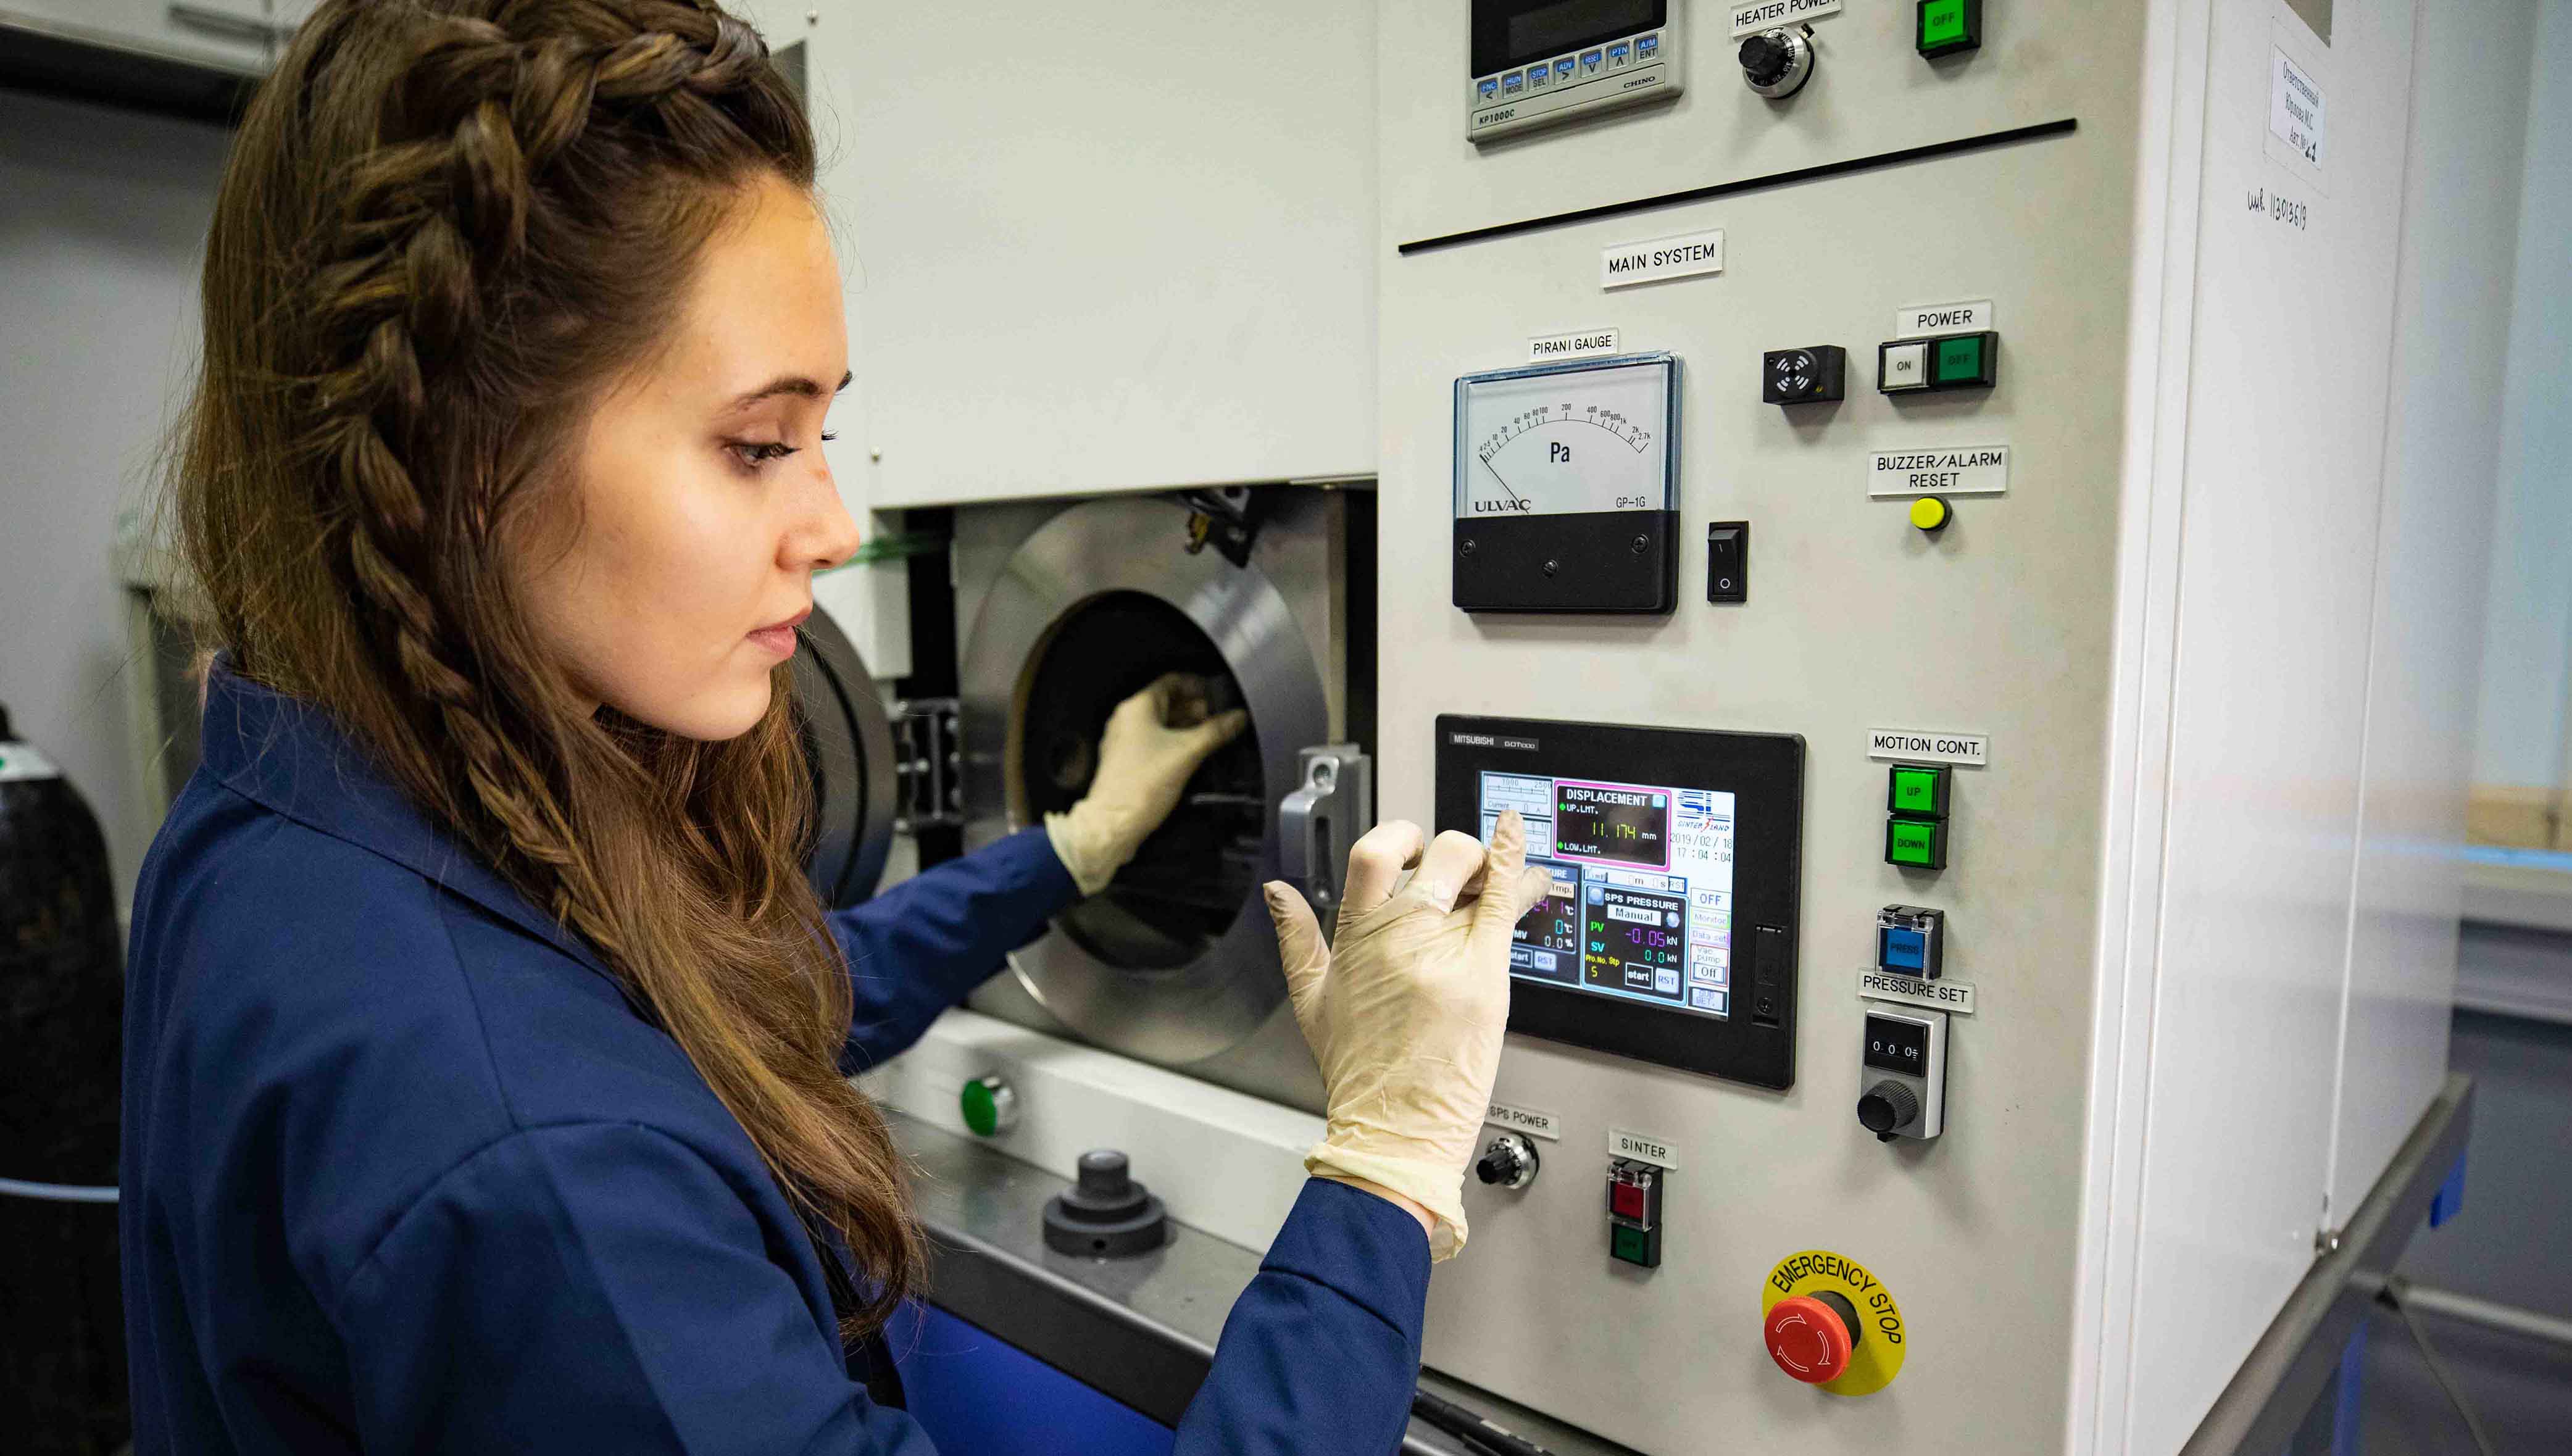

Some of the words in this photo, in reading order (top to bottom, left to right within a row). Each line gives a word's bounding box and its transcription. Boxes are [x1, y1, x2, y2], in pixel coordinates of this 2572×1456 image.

[1736, 2, 1784, 27] HEATER
[1791, 0, 1836, 12] POW
[1933, 12, 1955, 26] OFF
[1639, 48, 1655, 59] ENT
[1533, 78, 1546, 88] SEL
[1623, 76, 1655, 88] CHINO
[1480, 109, 1515, 124] KP1000C
[1609, 253, 1647, 274] MAIN
[1653, 243, 1715, 266] SYSTEM
[1918, 310, 1973, 328] POWER
[1533, 339, 1571, 355] PIRANI
[1575, 335, 1612, 350] GAUGE
[1897, 360, 1912, 371] ON
[1561, 403, 1571, 412] 200
[1587, 406, 1597, 414] 400
[1600, 410, 1610, 418] 600
[1638, 432, 1650, 440] 2.7k
[1550, 442, 1570, 464] Pa
[1877, 452, 2002, 470] BUZZER/ALARM
[1910, 473, 1960, 488] RESET
[1474, 499, 1531, 512] ULVAC
[1616, 496, 1646, 508] GP-1G
[1454, 734, 1494, 746] MITSUBISHI
[1874, 735, 1931, 752] MOTION
[1937, 740, 1980, 755] CONT.
[1907, 786, 1921, 796] UP
[1567, 789, 1647, 807] DISPLACEMENT
[1678, 820, 1703, 829] SINTER
[1642, 832, 1657, 840] mm
[1897, 838, 1925, 849] DOWN
[1605, 893, 1623, 903] SPS
[1627, 896, 1679, 911] PRESSURE
[1699, 893, 1721, 905] OFF
[1615, 907, 1653, 921] Manual
[1590, 921, 1605, 933] PV
[1513, 930, 1528, 940] MV
[1591, 941, 1605, 952] SV
[1891, 943, 1919, 955] PRESS
[1628, 970, 1650, 982] start
[1701, 967, 1718, 978] Off
[1658, 975, 1675, 986] RST
[1863, 975, 1935, 998] PRESSURE
[1939, 987, 1968, 1003] SET
[1490, 1105, 1509, 1120] SPS
[1513, 1111, 1549, 1129] POWER
[1621, 1138, 1667, 1160] SINTER
[1771, 1254, 1877, 1294] EMERGENCY
[1869, 1292, 1902, 1345] STOP
